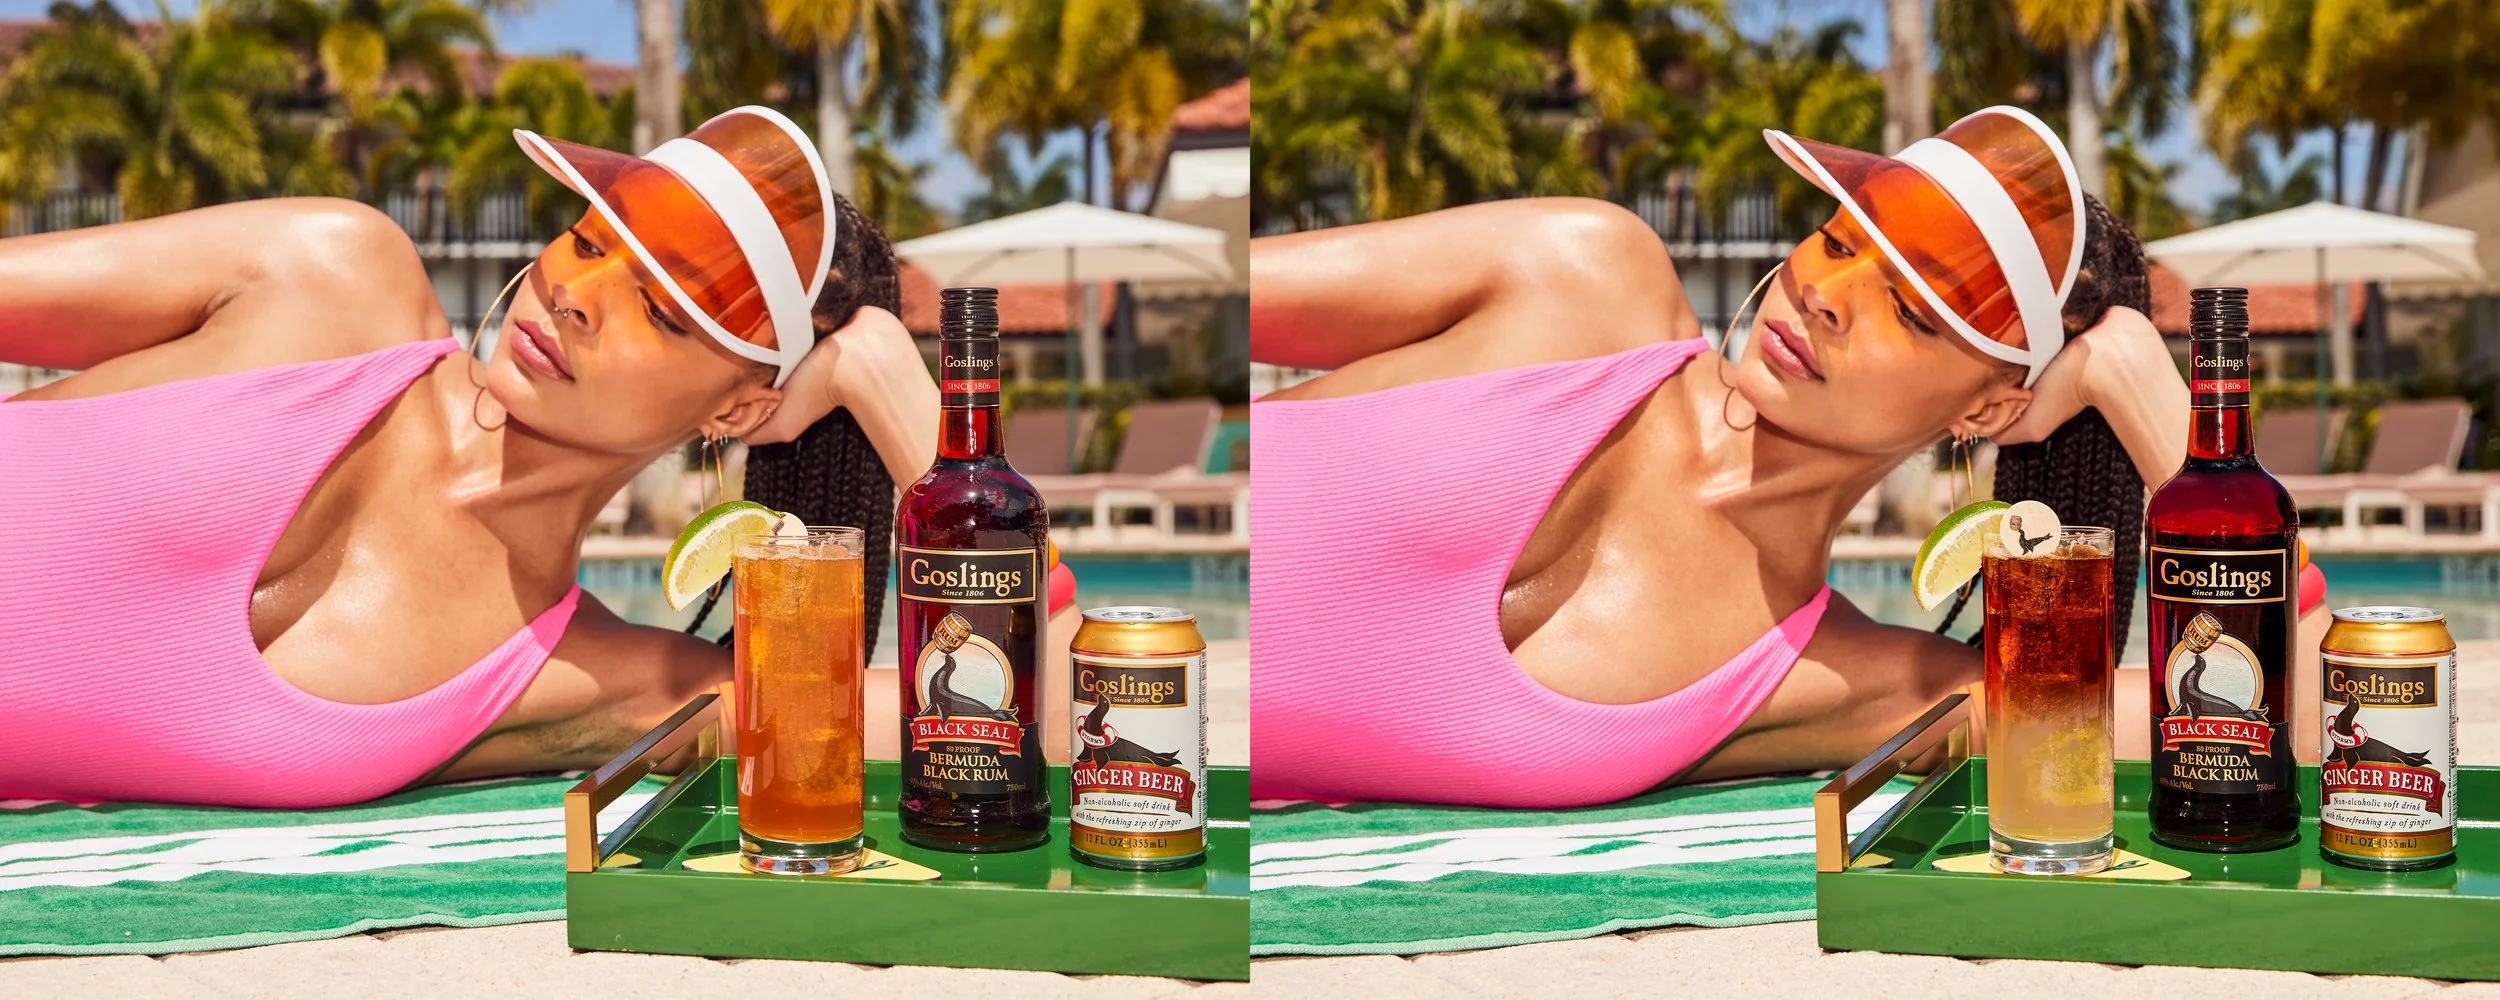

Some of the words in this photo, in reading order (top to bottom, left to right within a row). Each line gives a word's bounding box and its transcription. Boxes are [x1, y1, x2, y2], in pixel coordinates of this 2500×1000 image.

[945, 355, 994, 371] Goslings
[2195, 355, 2244, 371] Goslings
[947, 383, 971, 391] SINCE
[974, 382, 991, 390] 1806
[2197, 383, 2221, 391] SINCE
[2224, 382, 2241, 390] 1806
[910, 558, 1022, 597] Goslings
[2160, 558, 2272, 597] Goslings
[940, 627, 958, 645] RUM
[2190, 627, 2208, 645] RUM
[1080, 669, 1175, 703] Goslings
[2330, 669, 2425, 703] Goslings
[919, 722, 967, 736] BLACK
[971, 723, 1011, 740] SEAL
[2169, 722, 2217, 736] BLACK
[2221, 723, 2261, 740] SEAL
[946, 745, 955, 753] 80
[2196, 745, 2205, 753] 80
[929, 751, 1001, 767] BERMUDA
[2179, 751, 2251, 767] BERMUDA
[923, 764, 971, 781] BLACK
[973, 768, 1010, 782] RUM
[1073, 768, 1134, 787] GINGER
[1138, 771, 1184, 794] BEER
[2173, 764, 2221, 781] BLACK
[2223, 768, 2260, 782] RUM
[2323, 768, 2384, 787] GINGER
[2388, 771, 2434, 794] BEER
[1083, 797, 1131, 808] Non-alcoholic
[1133, 800, 1149, 810] soft
[1151, 801, 1171, 811] drink
[2333, 797, 2381, 808] Non-alcoholic
[2383, 800, 2399, 810] soft
[2401, 801, 2421, 811] drink
[1095, 815, 1132, 829] refreshing
[1134, 819, 1147, 829] zip
[1149, 818, 1159, 828] of
[1159, 818, 1182, 829] ginger
[2345, 815, 2382, 829] refreshing
[2384, 819, 2397, 829] zip
[2399, 818, 2409, 828] of
[2409, 818, 2432, 829] ginger
[1086, 833, 1093, 843] 12
[2336, 833, 2343, 843] 12
